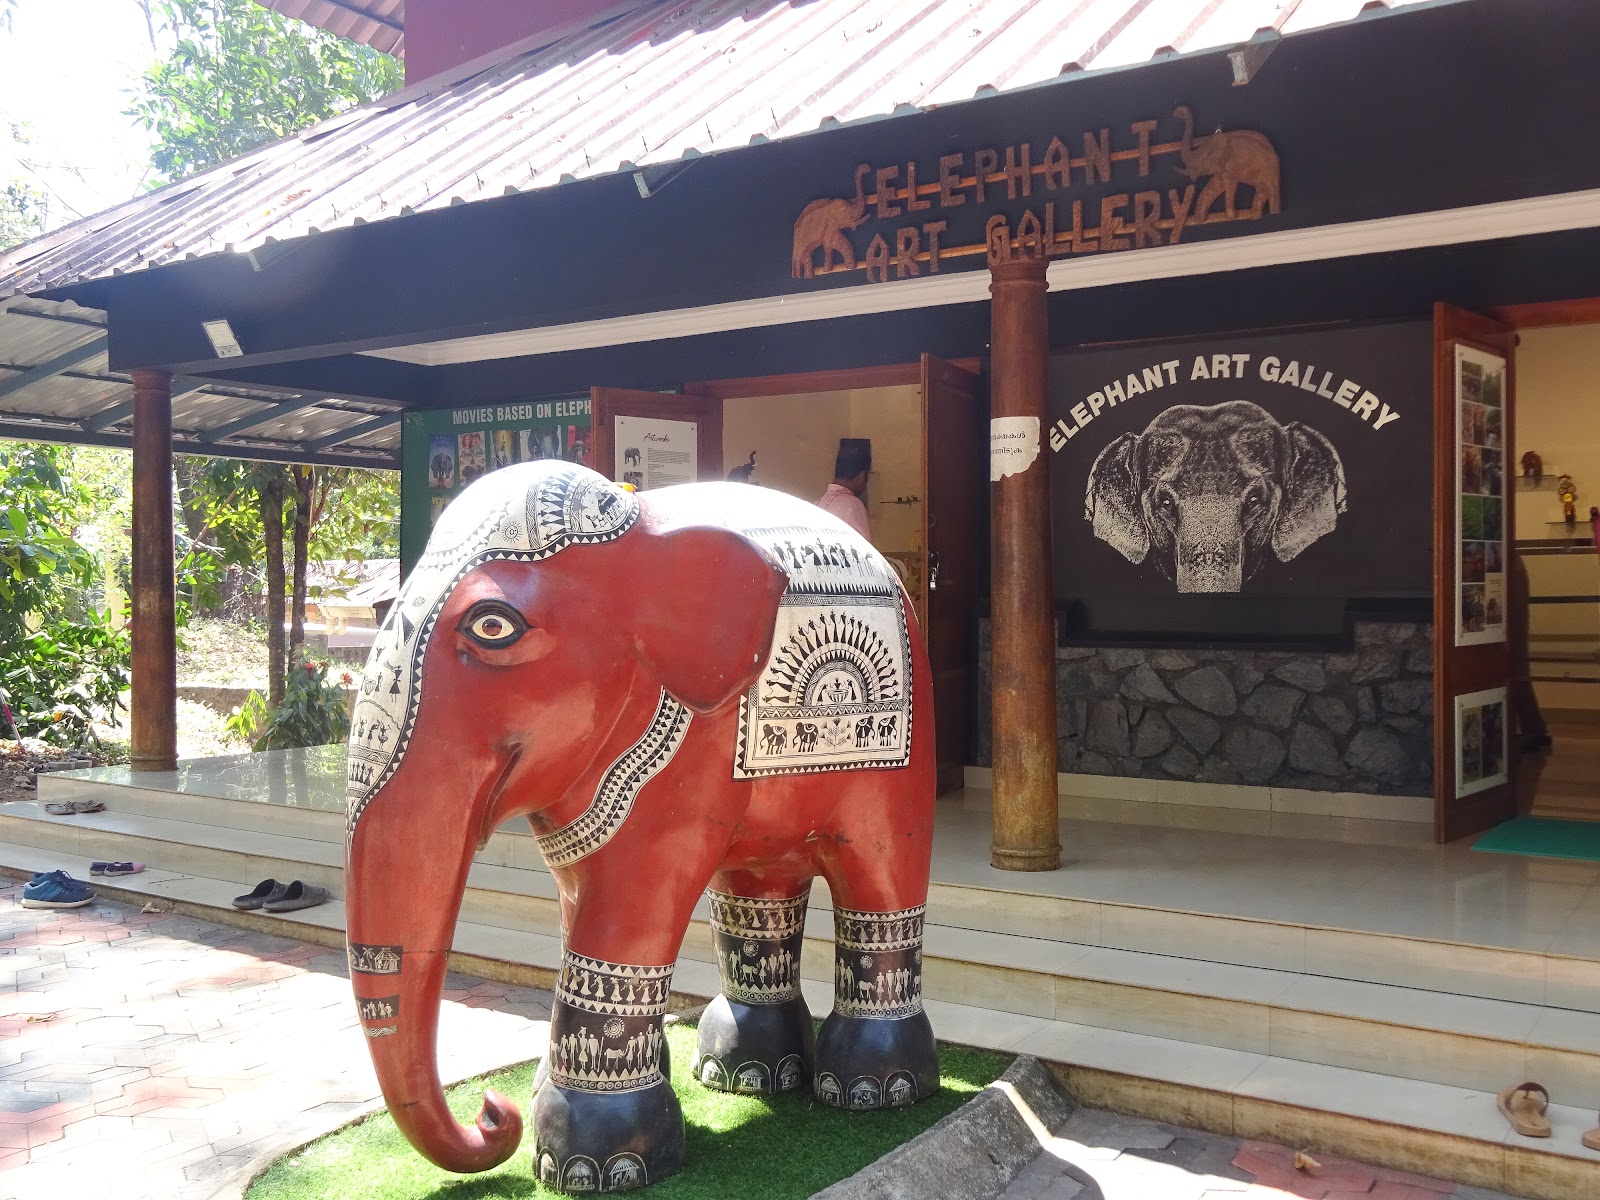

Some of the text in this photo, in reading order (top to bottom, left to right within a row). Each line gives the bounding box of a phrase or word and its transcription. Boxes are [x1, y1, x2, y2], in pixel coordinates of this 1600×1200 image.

[876, 120, 1158, 219] ELEPHANT
[866, 184, 1195, 283] ART GALLERY
[452, 408, 494, 425] MOVIES
[496, 404, 533, 422] BASED
[536, 403, 552, 419] ON
[1049, 353, 1401, 453] ELEPHANT ART GALLERY
